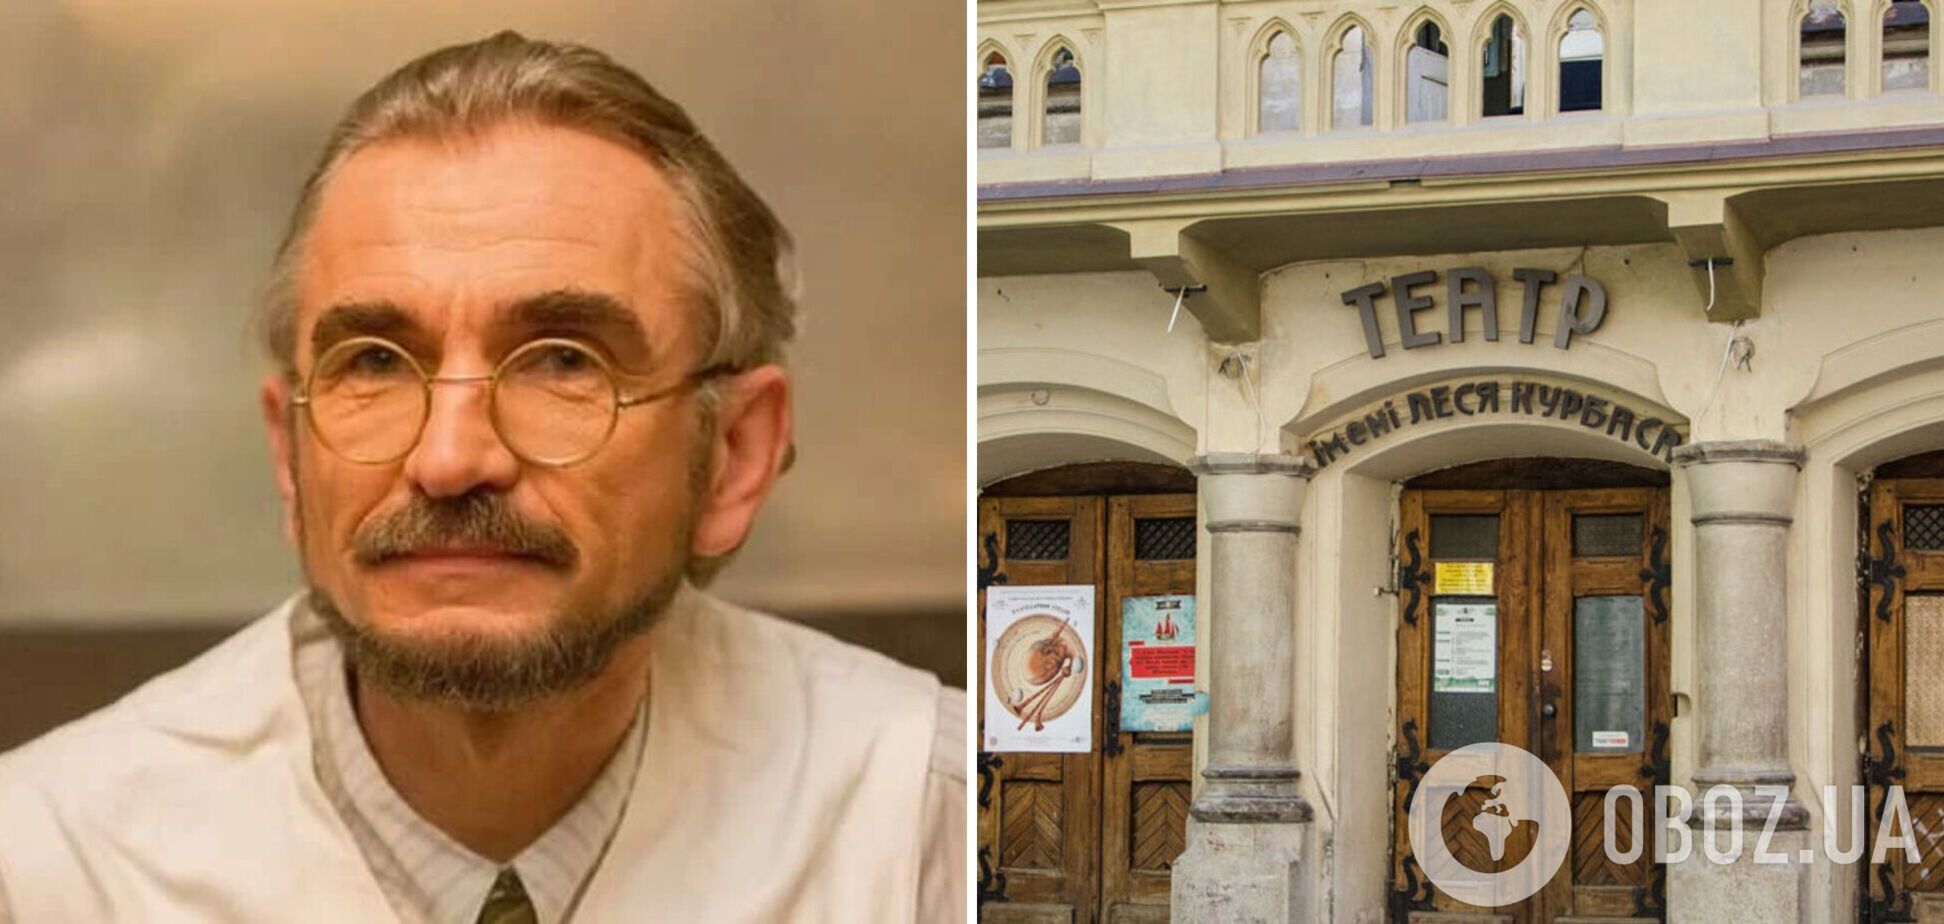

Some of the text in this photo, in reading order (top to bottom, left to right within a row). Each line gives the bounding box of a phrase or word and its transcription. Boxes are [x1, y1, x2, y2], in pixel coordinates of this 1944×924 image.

[1341, 266, 1609, 360] ТЕАТР
[1307, 381, 1683, 468] імені ЛЕСЯ КУРБАСА
